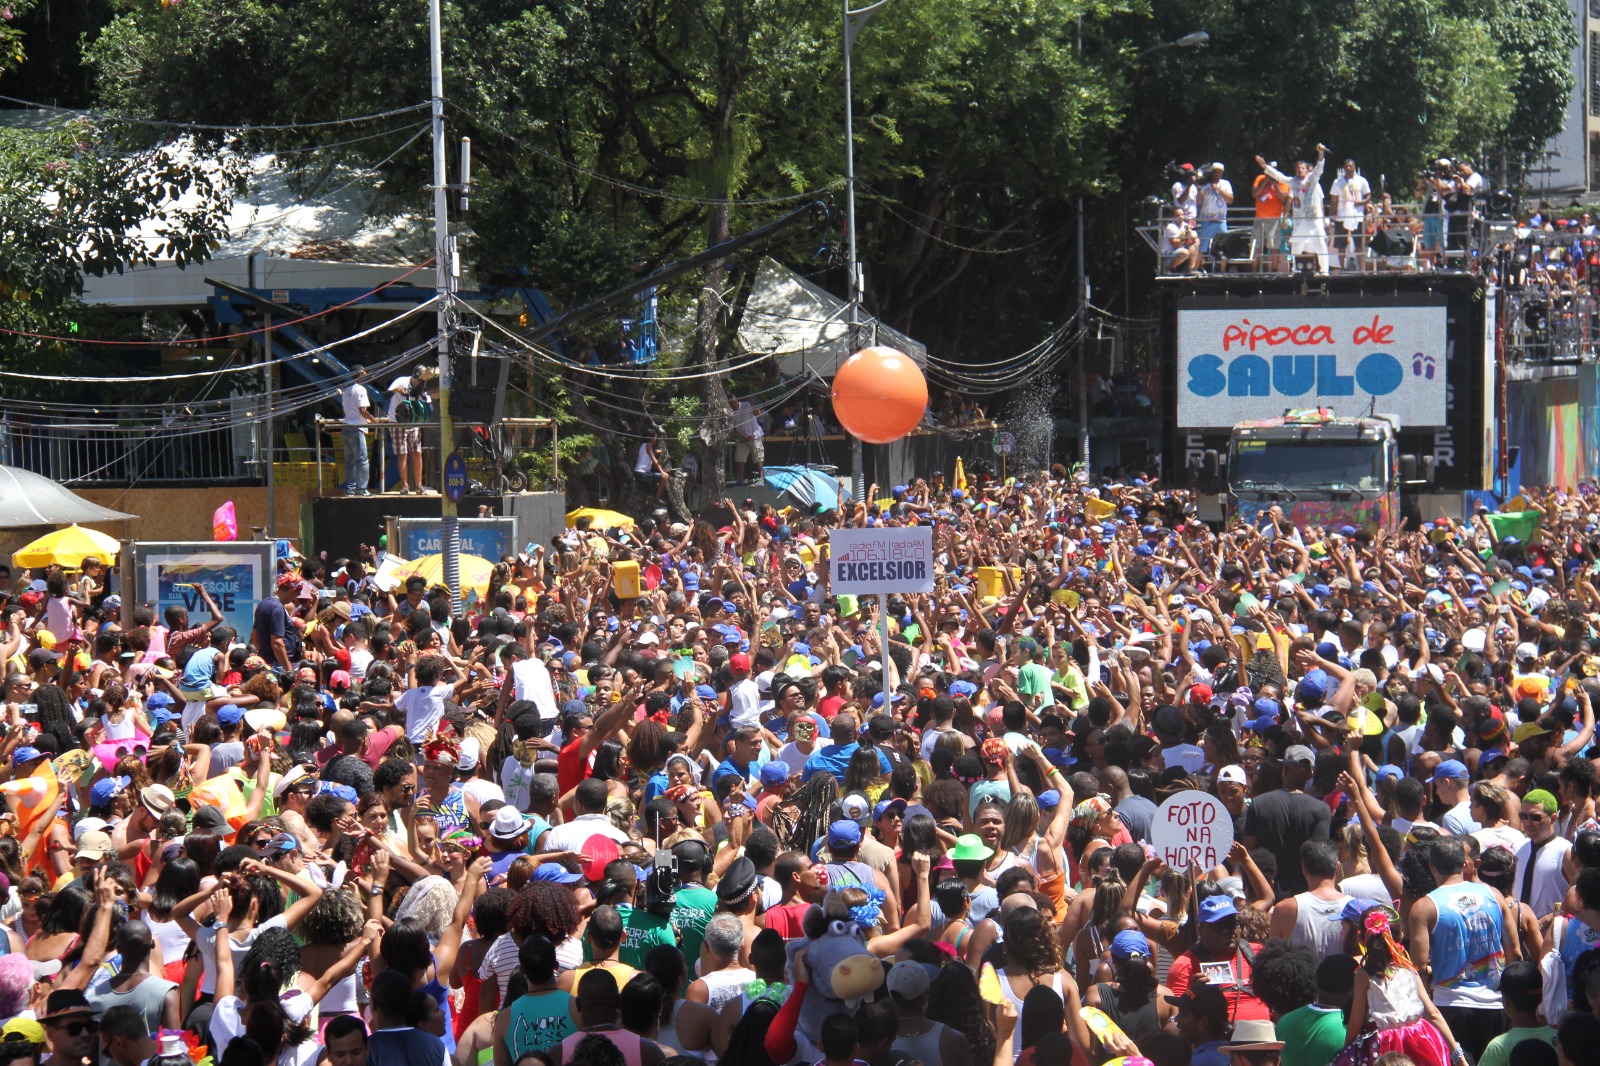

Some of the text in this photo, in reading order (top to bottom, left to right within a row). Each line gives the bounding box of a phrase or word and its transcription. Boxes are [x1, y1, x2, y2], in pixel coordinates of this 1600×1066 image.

[1223, 314, 1395, 351] pipoca de
[1187, 352, 1403, 397] SAULO
[417, 538, 474, 551] CARVAL
[850, 548, 925, 562] 106.1 840
[837, 560, 926, 582] EXCELSIOR
[168, 592, 236, 612] SUA VIBE
[1167, 801, 1216, 826] FOTO
[1186, 826, 1211, 844] NA
[1165, 845, 1217, 869] HORA
[521, 1015, 568, 1031] WORK
[524, 1031, 565, 1046] LESS
